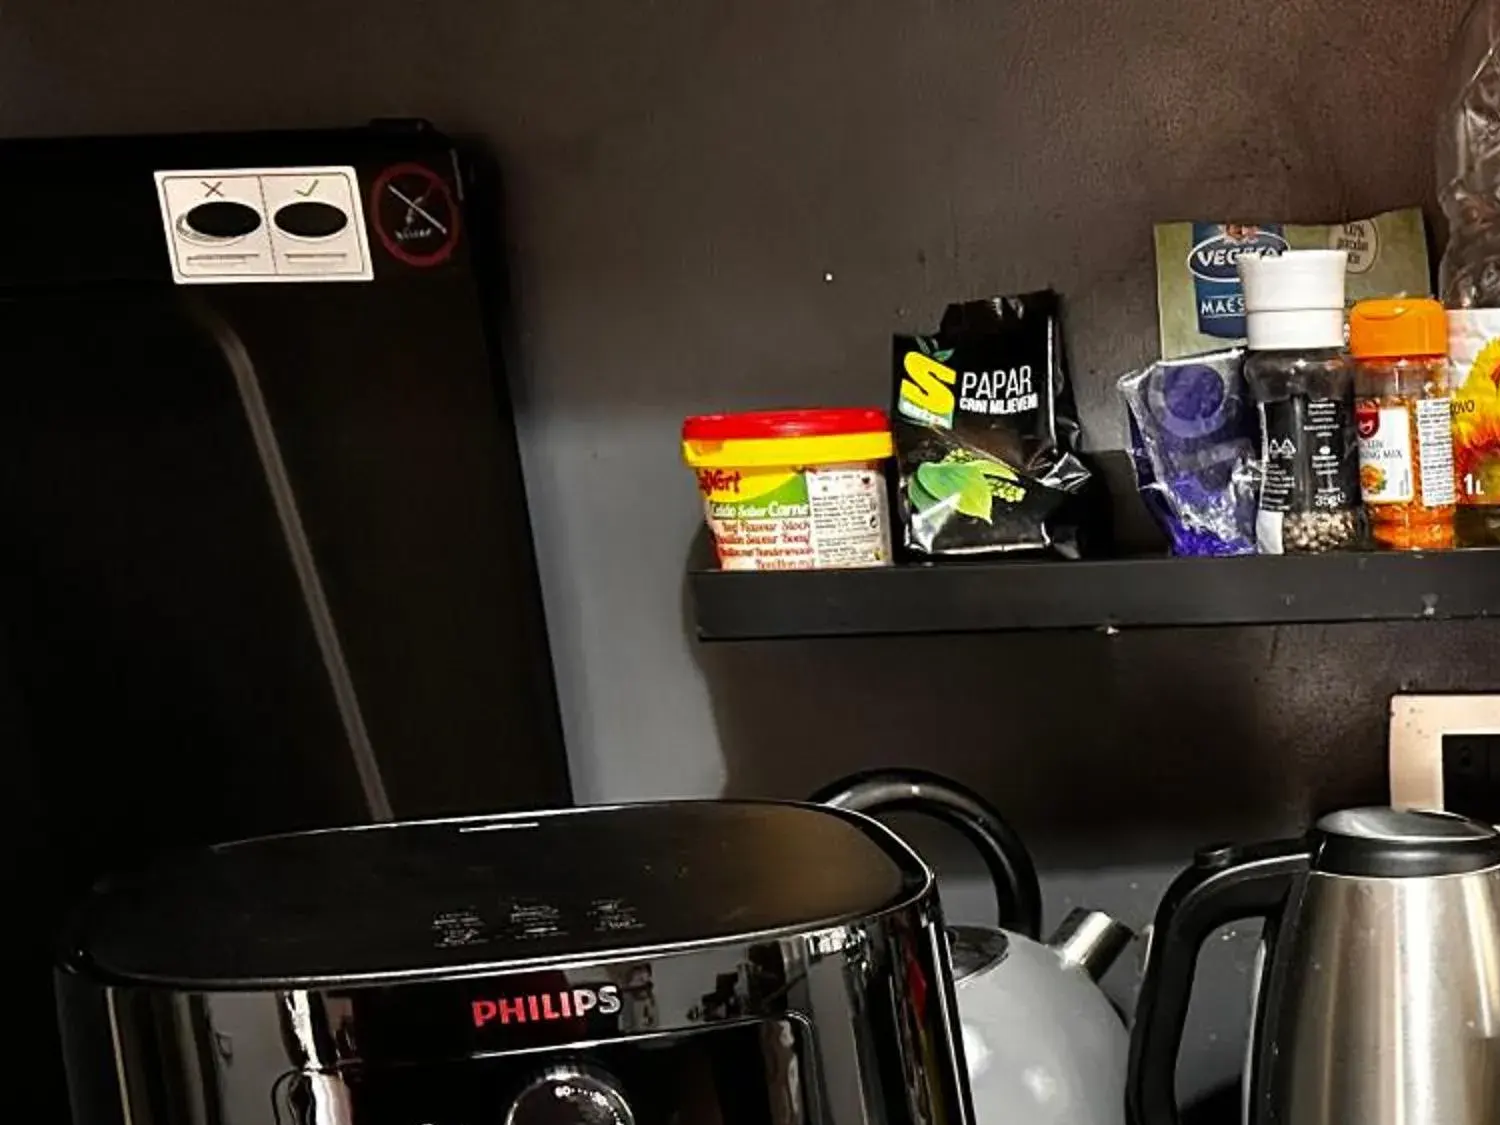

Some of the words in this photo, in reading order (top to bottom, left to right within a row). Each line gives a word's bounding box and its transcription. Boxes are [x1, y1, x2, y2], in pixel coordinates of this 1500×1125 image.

[1201, 297, 1246, 315] MAES
[961, 365, 1033, 400] PAPAR
[470, 985, 622, 1027] PHILIPS
